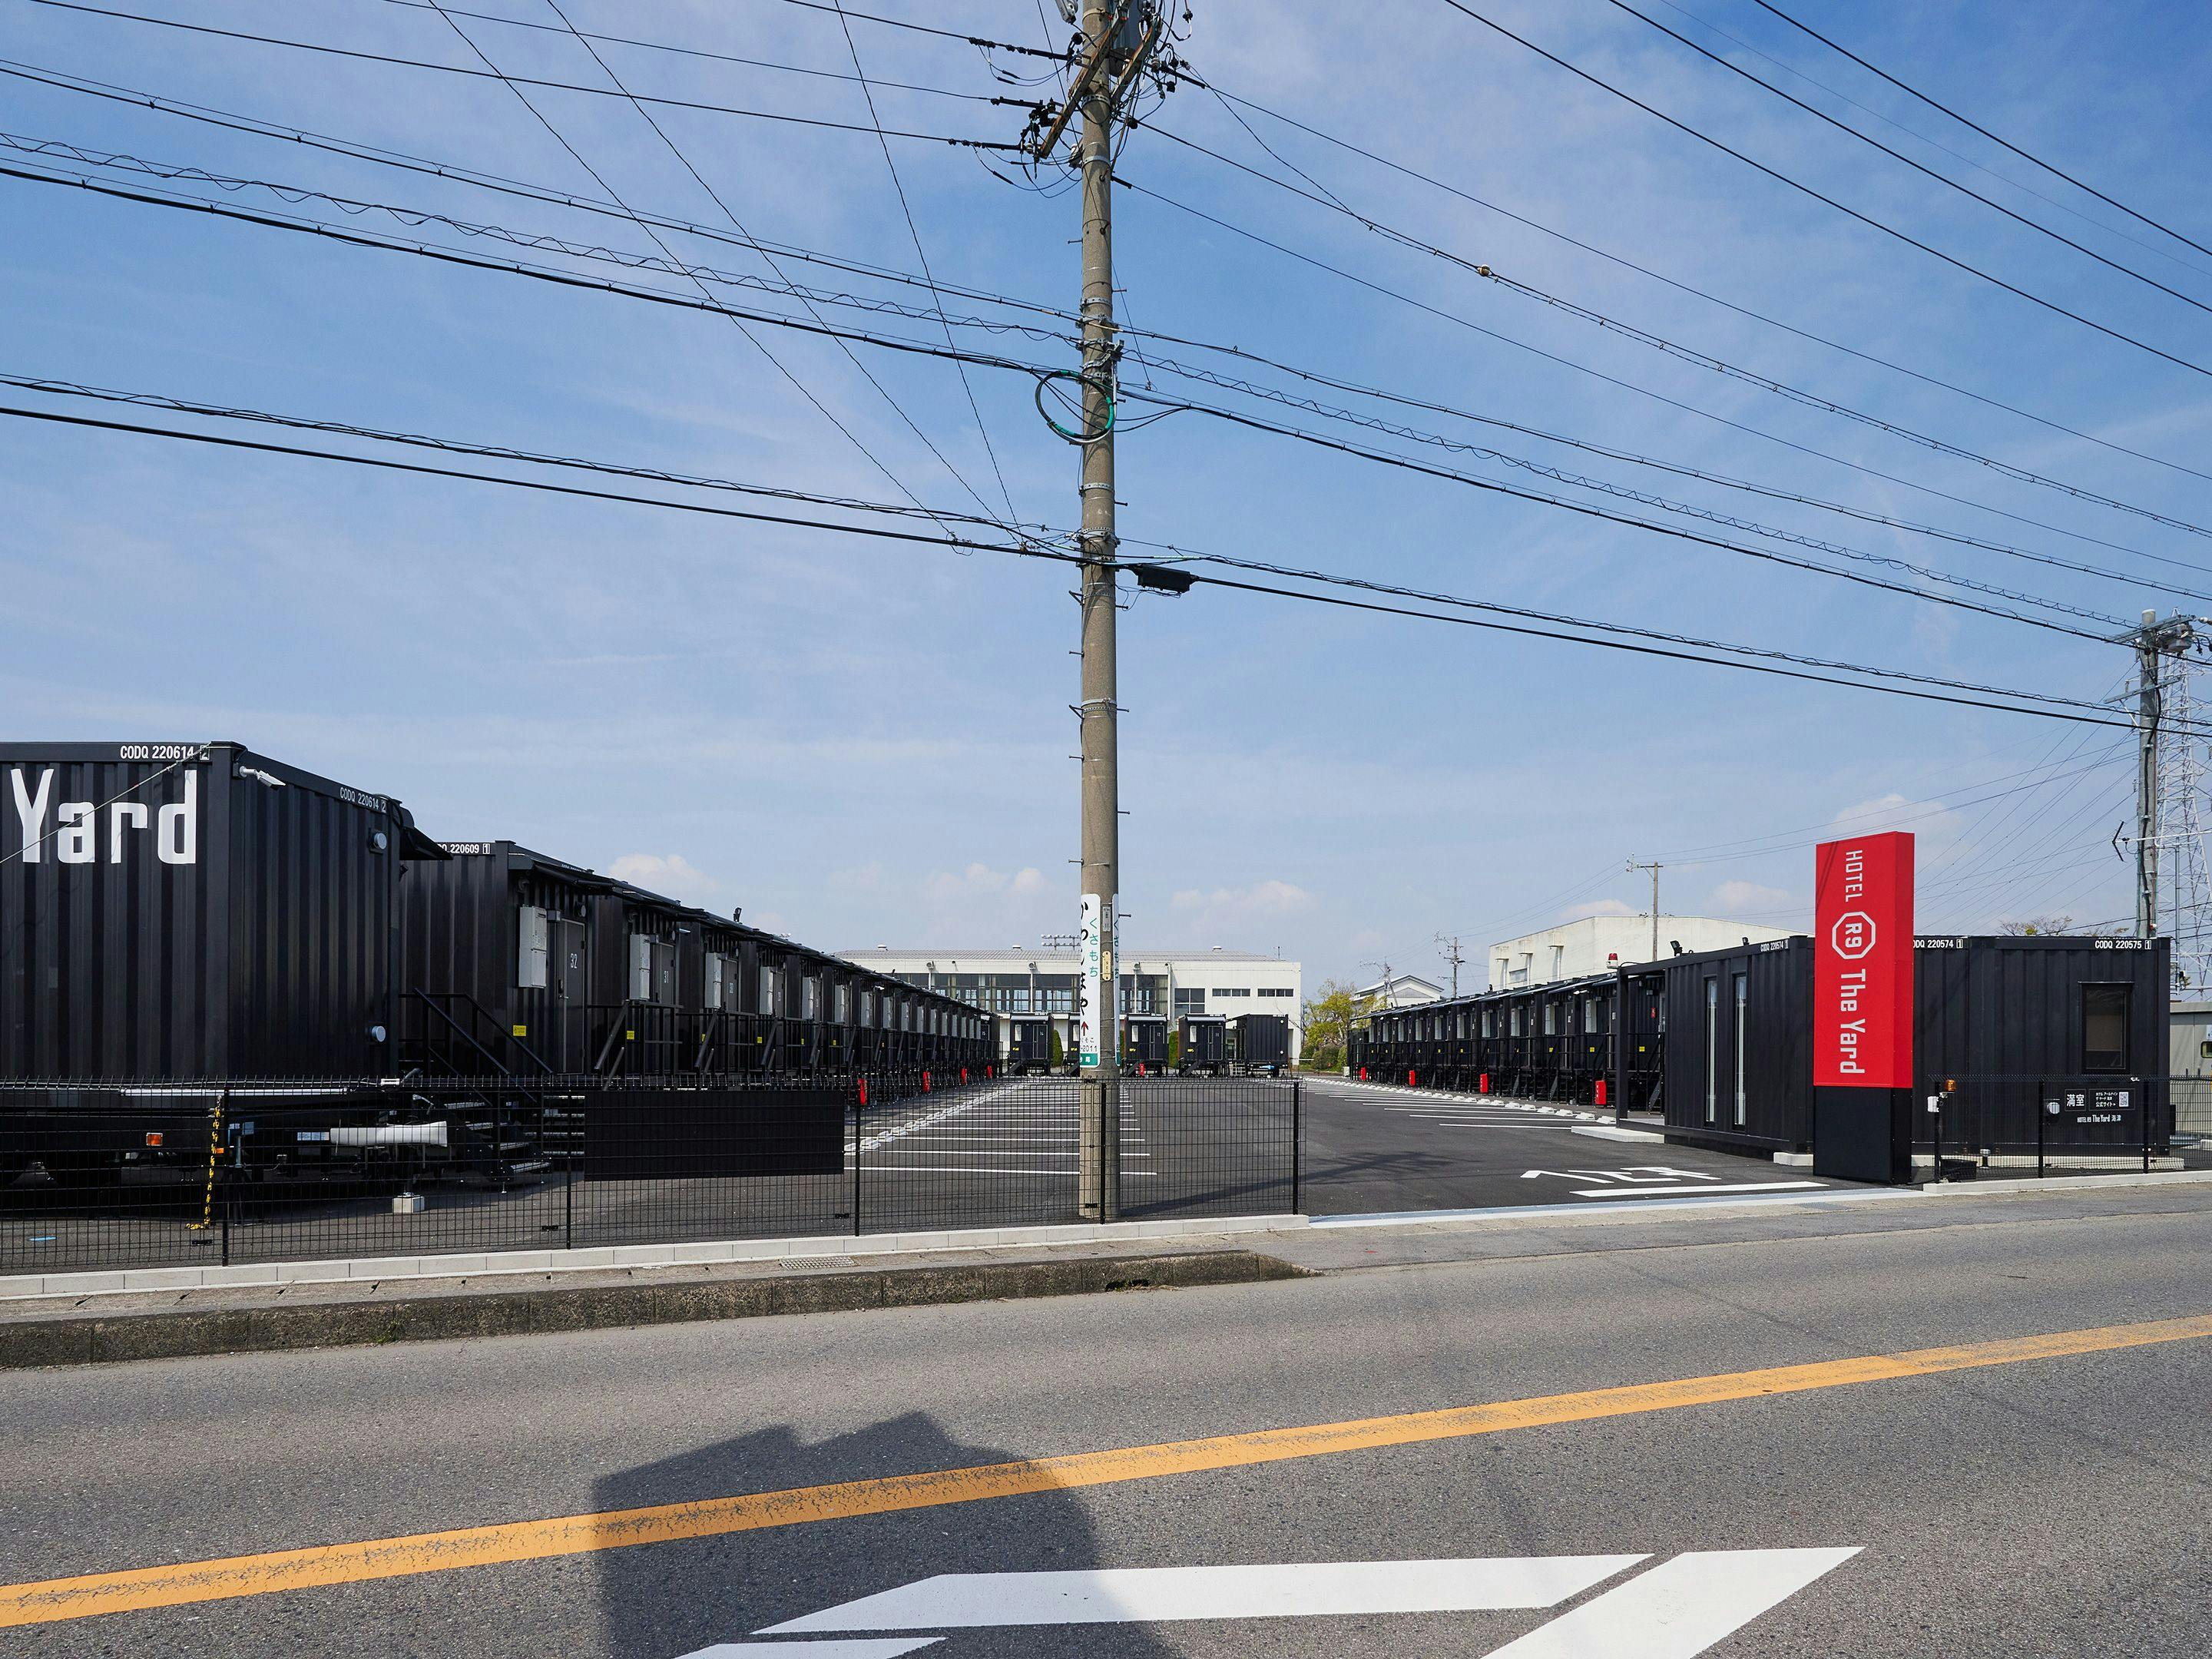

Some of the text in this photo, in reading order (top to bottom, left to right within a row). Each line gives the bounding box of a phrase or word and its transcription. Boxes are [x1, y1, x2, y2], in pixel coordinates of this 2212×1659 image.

[121, 745, 148, 759] CODQ
[152, 745, 194, 759] 220614
[339, 787, 356, 803] CODQ
[358, 793, 379, 810] 220614
[11, 768, 197, 864] Yard
[450, 843, 479, 853] 220609
[1089, 917, 1098, 978] くさもち
[1927, 939, 1954, 948] 220574
[2094, 940, 2113, 949] CODQ
[2115, 940, 2142, 949] 220575
[571, 953, 578, 969] 32
[1839, 849, 1866, 1074] HOTEL R9 The Yard
[2066, 1093, 2085, 1107] 満室
